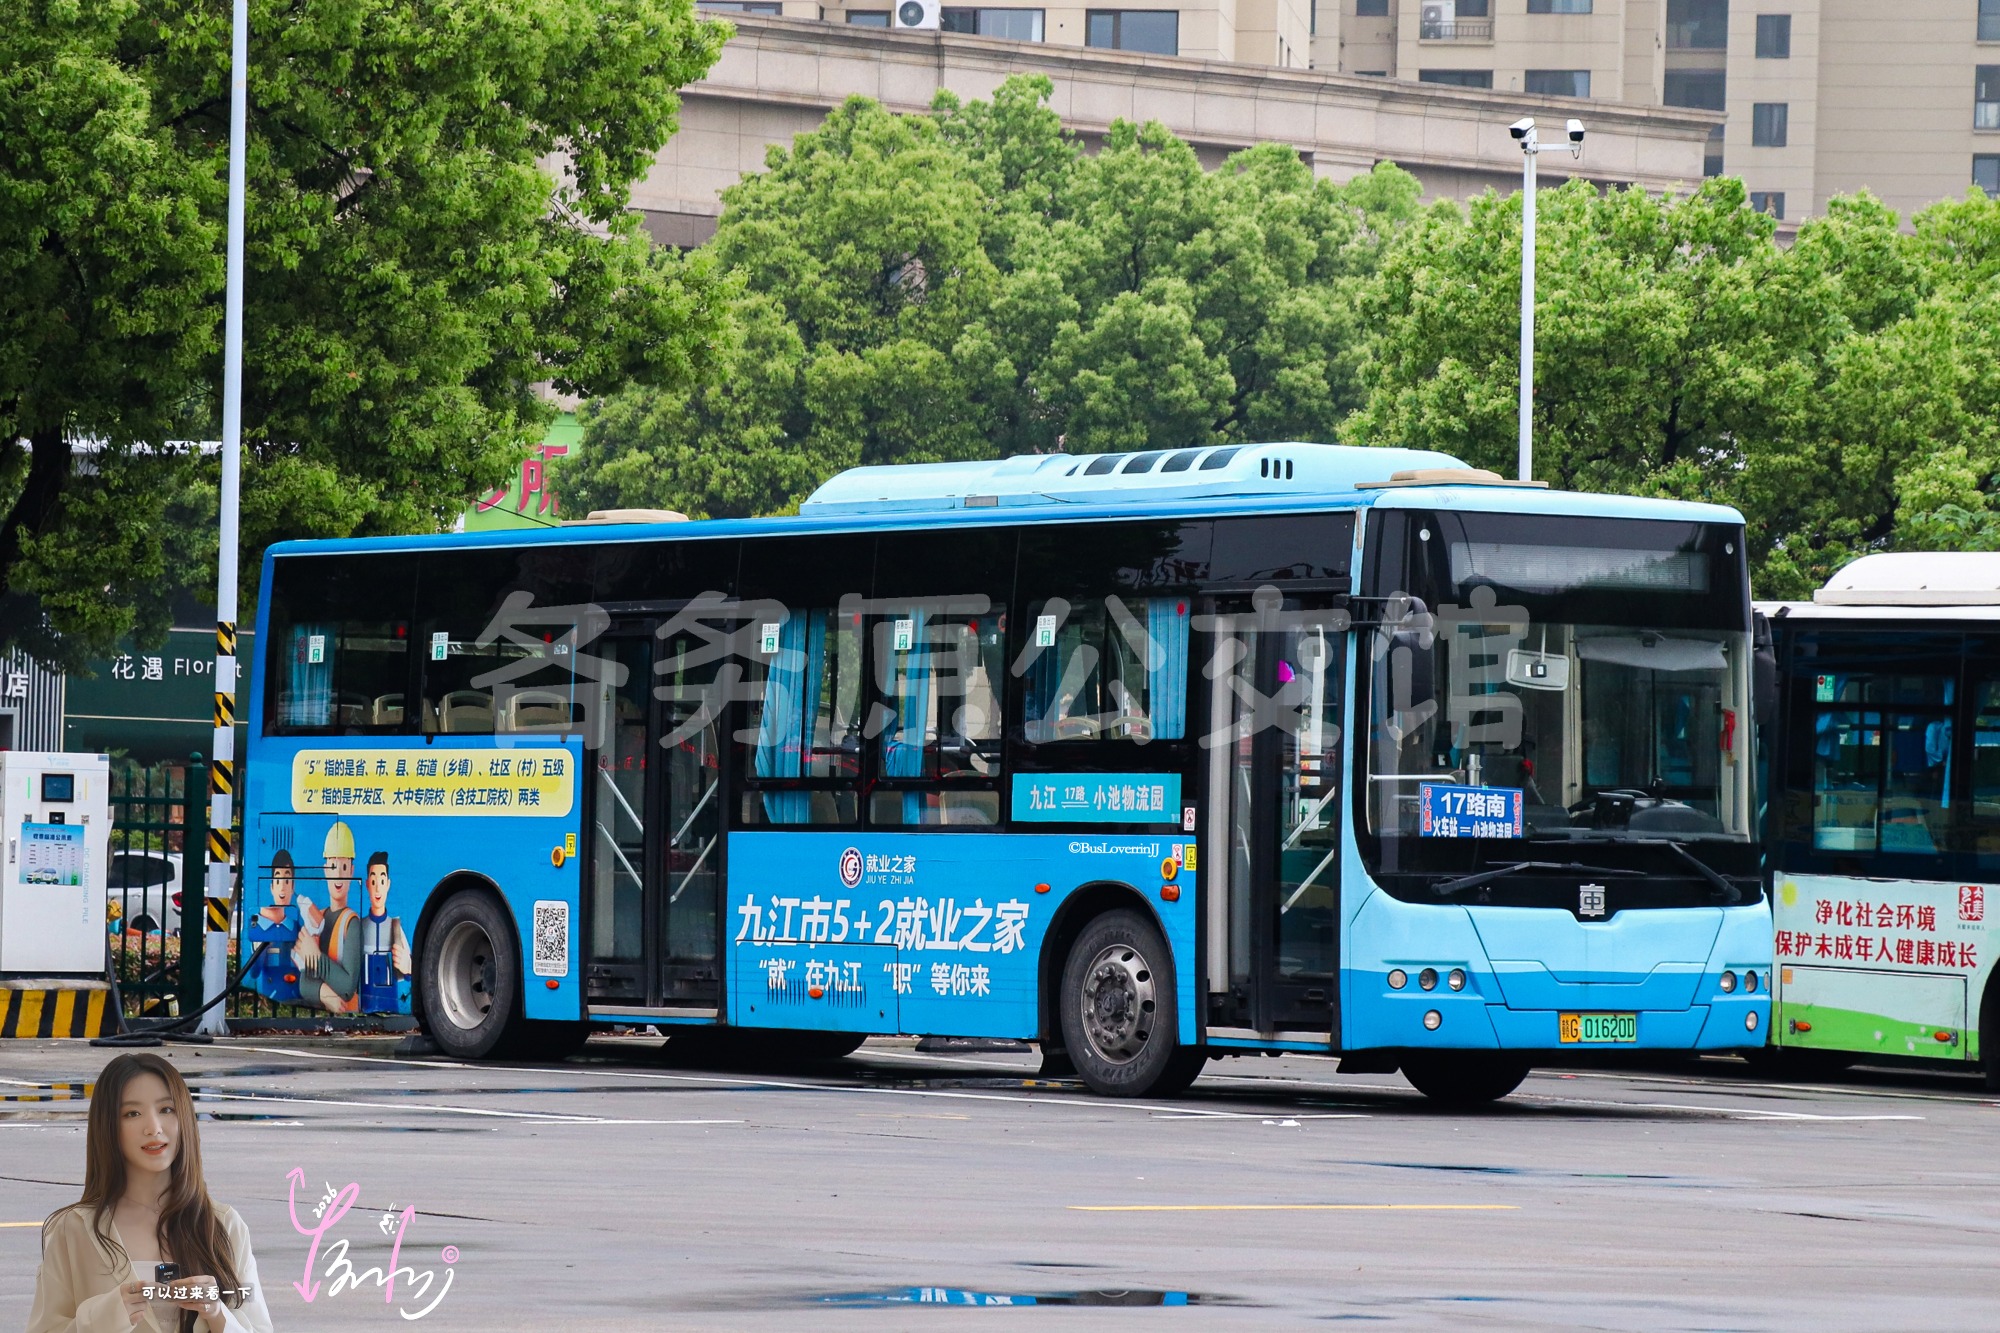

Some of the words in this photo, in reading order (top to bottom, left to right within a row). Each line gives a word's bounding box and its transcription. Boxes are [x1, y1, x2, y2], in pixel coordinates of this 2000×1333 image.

[111, 653, 163, 681] 花遇
[174, 658, 242, 678] Flort
[0, 671, 29, 698] 店
[1030, 784, 1056, 810] 九江
[1065, 786, 1085, 800] 17路
[1093, 784, 1164, 811] 小池物流园
[1441, 792, 1506, 818] 17路南
[866, 854, 916, 873] 就业之家
[866, 875, 876, 884] JIU
[877, 875, 887, 885] YE
[890, 875, 901, 885] ZHI
[903, 876, 914, 885] JIA
[735, 893, 1030, 954] 九江市5+2就业之家
[1815, 899, 1936, 932] 净化社会环境
[1774, 930, 1978, 968] 保护未成年人健康成长
